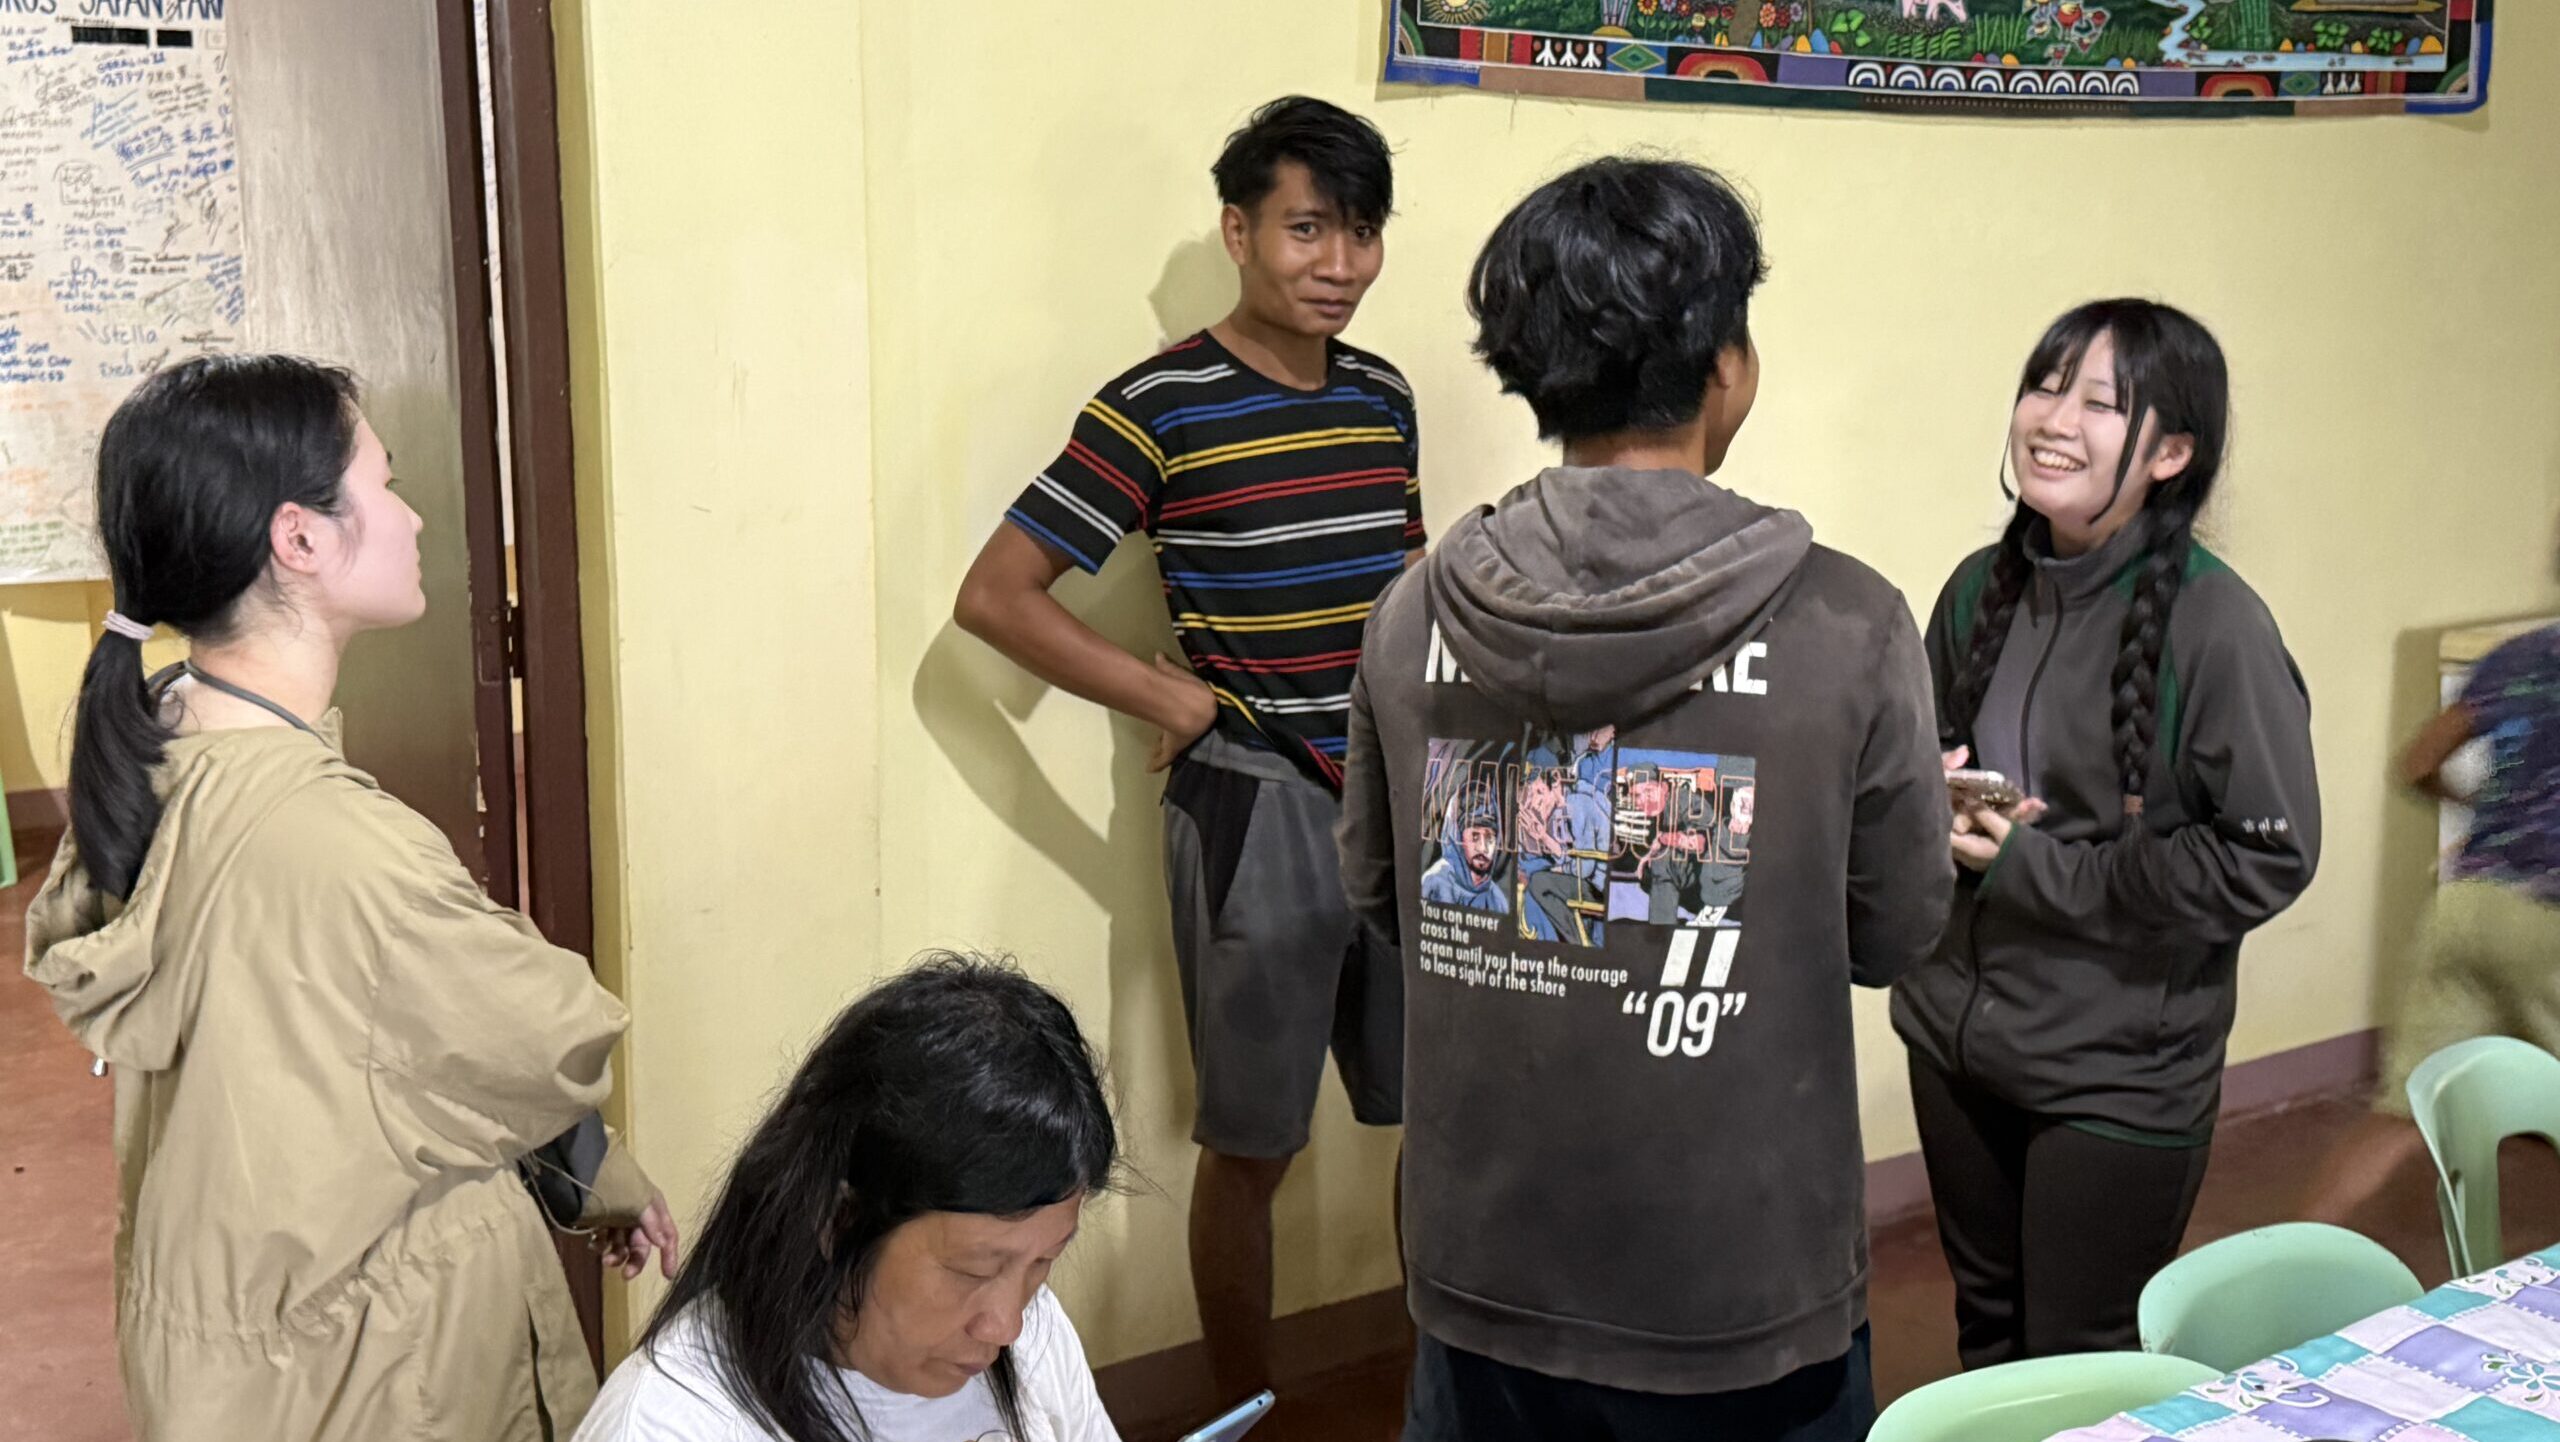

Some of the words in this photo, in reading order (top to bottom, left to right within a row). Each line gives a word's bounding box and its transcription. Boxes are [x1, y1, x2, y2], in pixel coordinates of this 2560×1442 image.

[1420, 899, 1440, 920] You
[1443, 909, 1463, 924] can
[1465, 913, 1499, 932] never
[1420, 921, 1448, 940] cross
[1450, 923, 1470, 944] the
[1420, 940, 1453, 959] ocean
[1456, 945, 1483, 965] until
[1485, 953, 1507, 971] you
[1511, 951, 1545, 974] have
[1548, 955, 1568, 978] the
[1570, 965, 1629, 988] courage
[1420, 955, 1432, 972] to
[1433, 954, 1457, 978] lose
[1459, 964, 1486, 988] sight
[1488, 969, 1503, 988] of
[1505, 971, 1527, 992] the
[1530, 974, 1567, 998] shore
